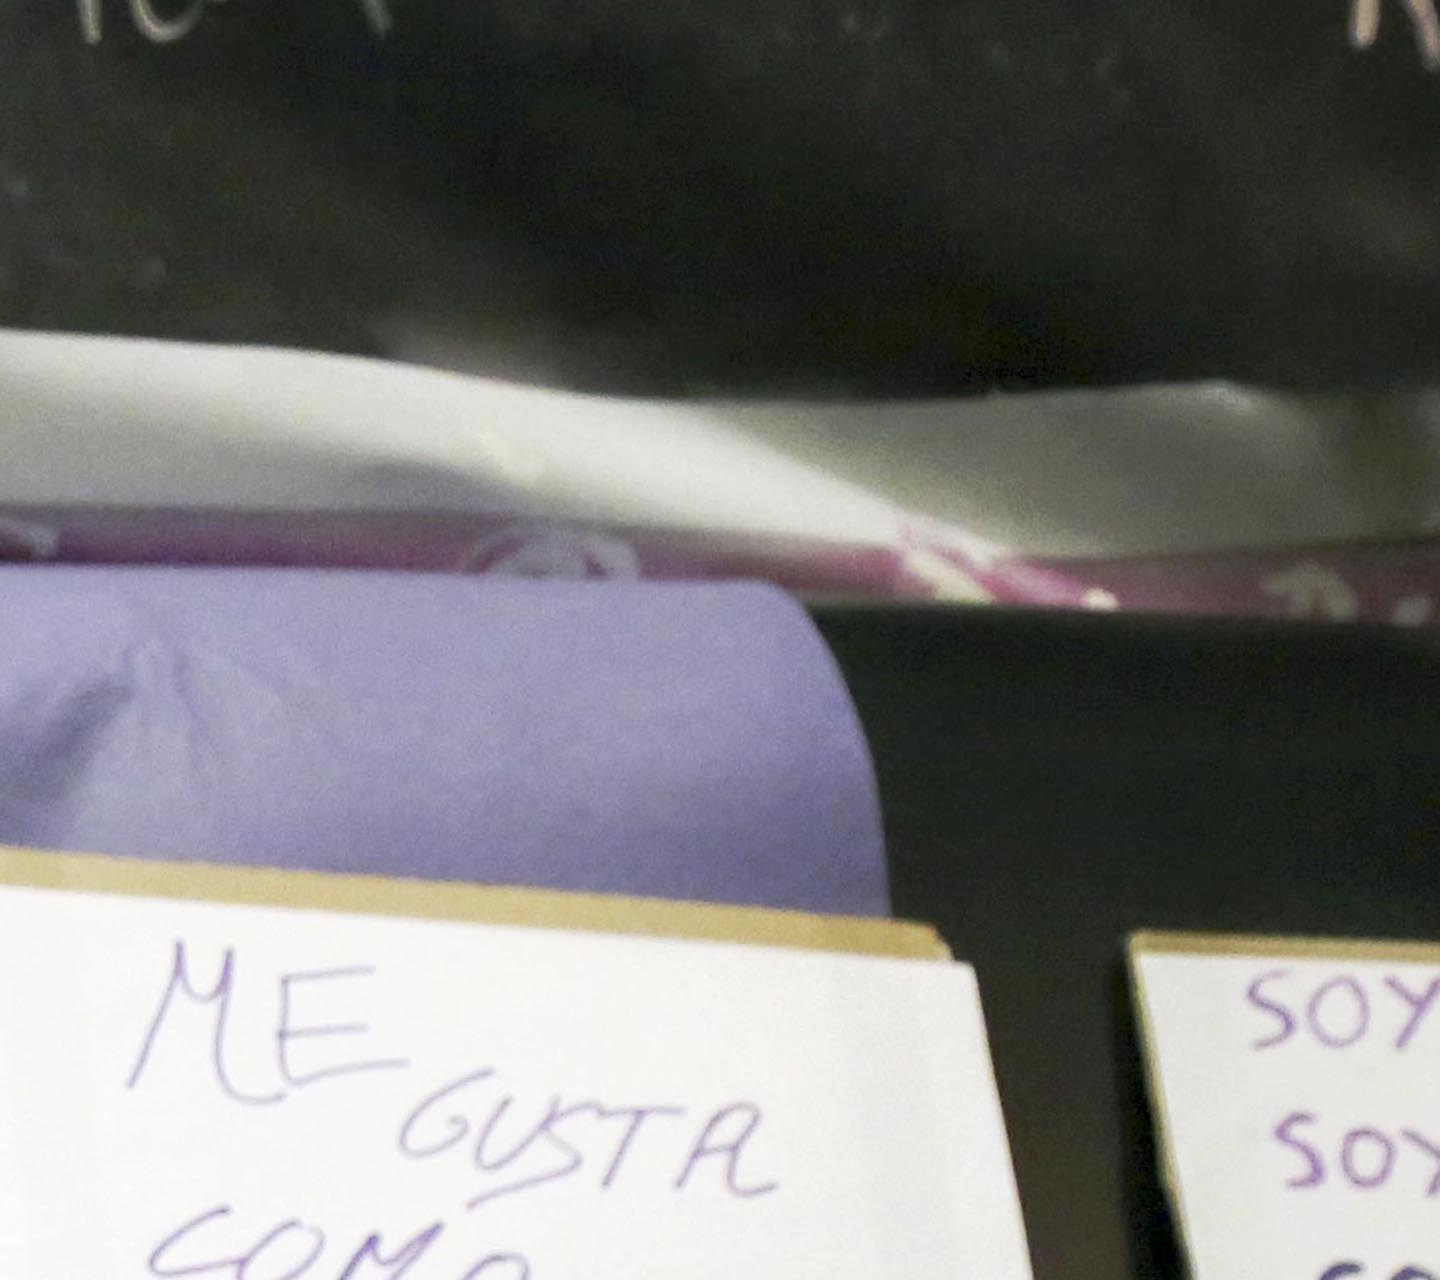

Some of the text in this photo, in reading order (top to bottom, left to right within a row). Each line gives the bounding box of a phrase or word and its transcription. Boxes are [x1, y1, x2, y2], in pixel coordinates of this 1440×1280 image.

[126, 939, 410, 1107] ME
[1247, 970, 1440, 1050] SOY
[397, 1067, 778, 1209] GUSTA
